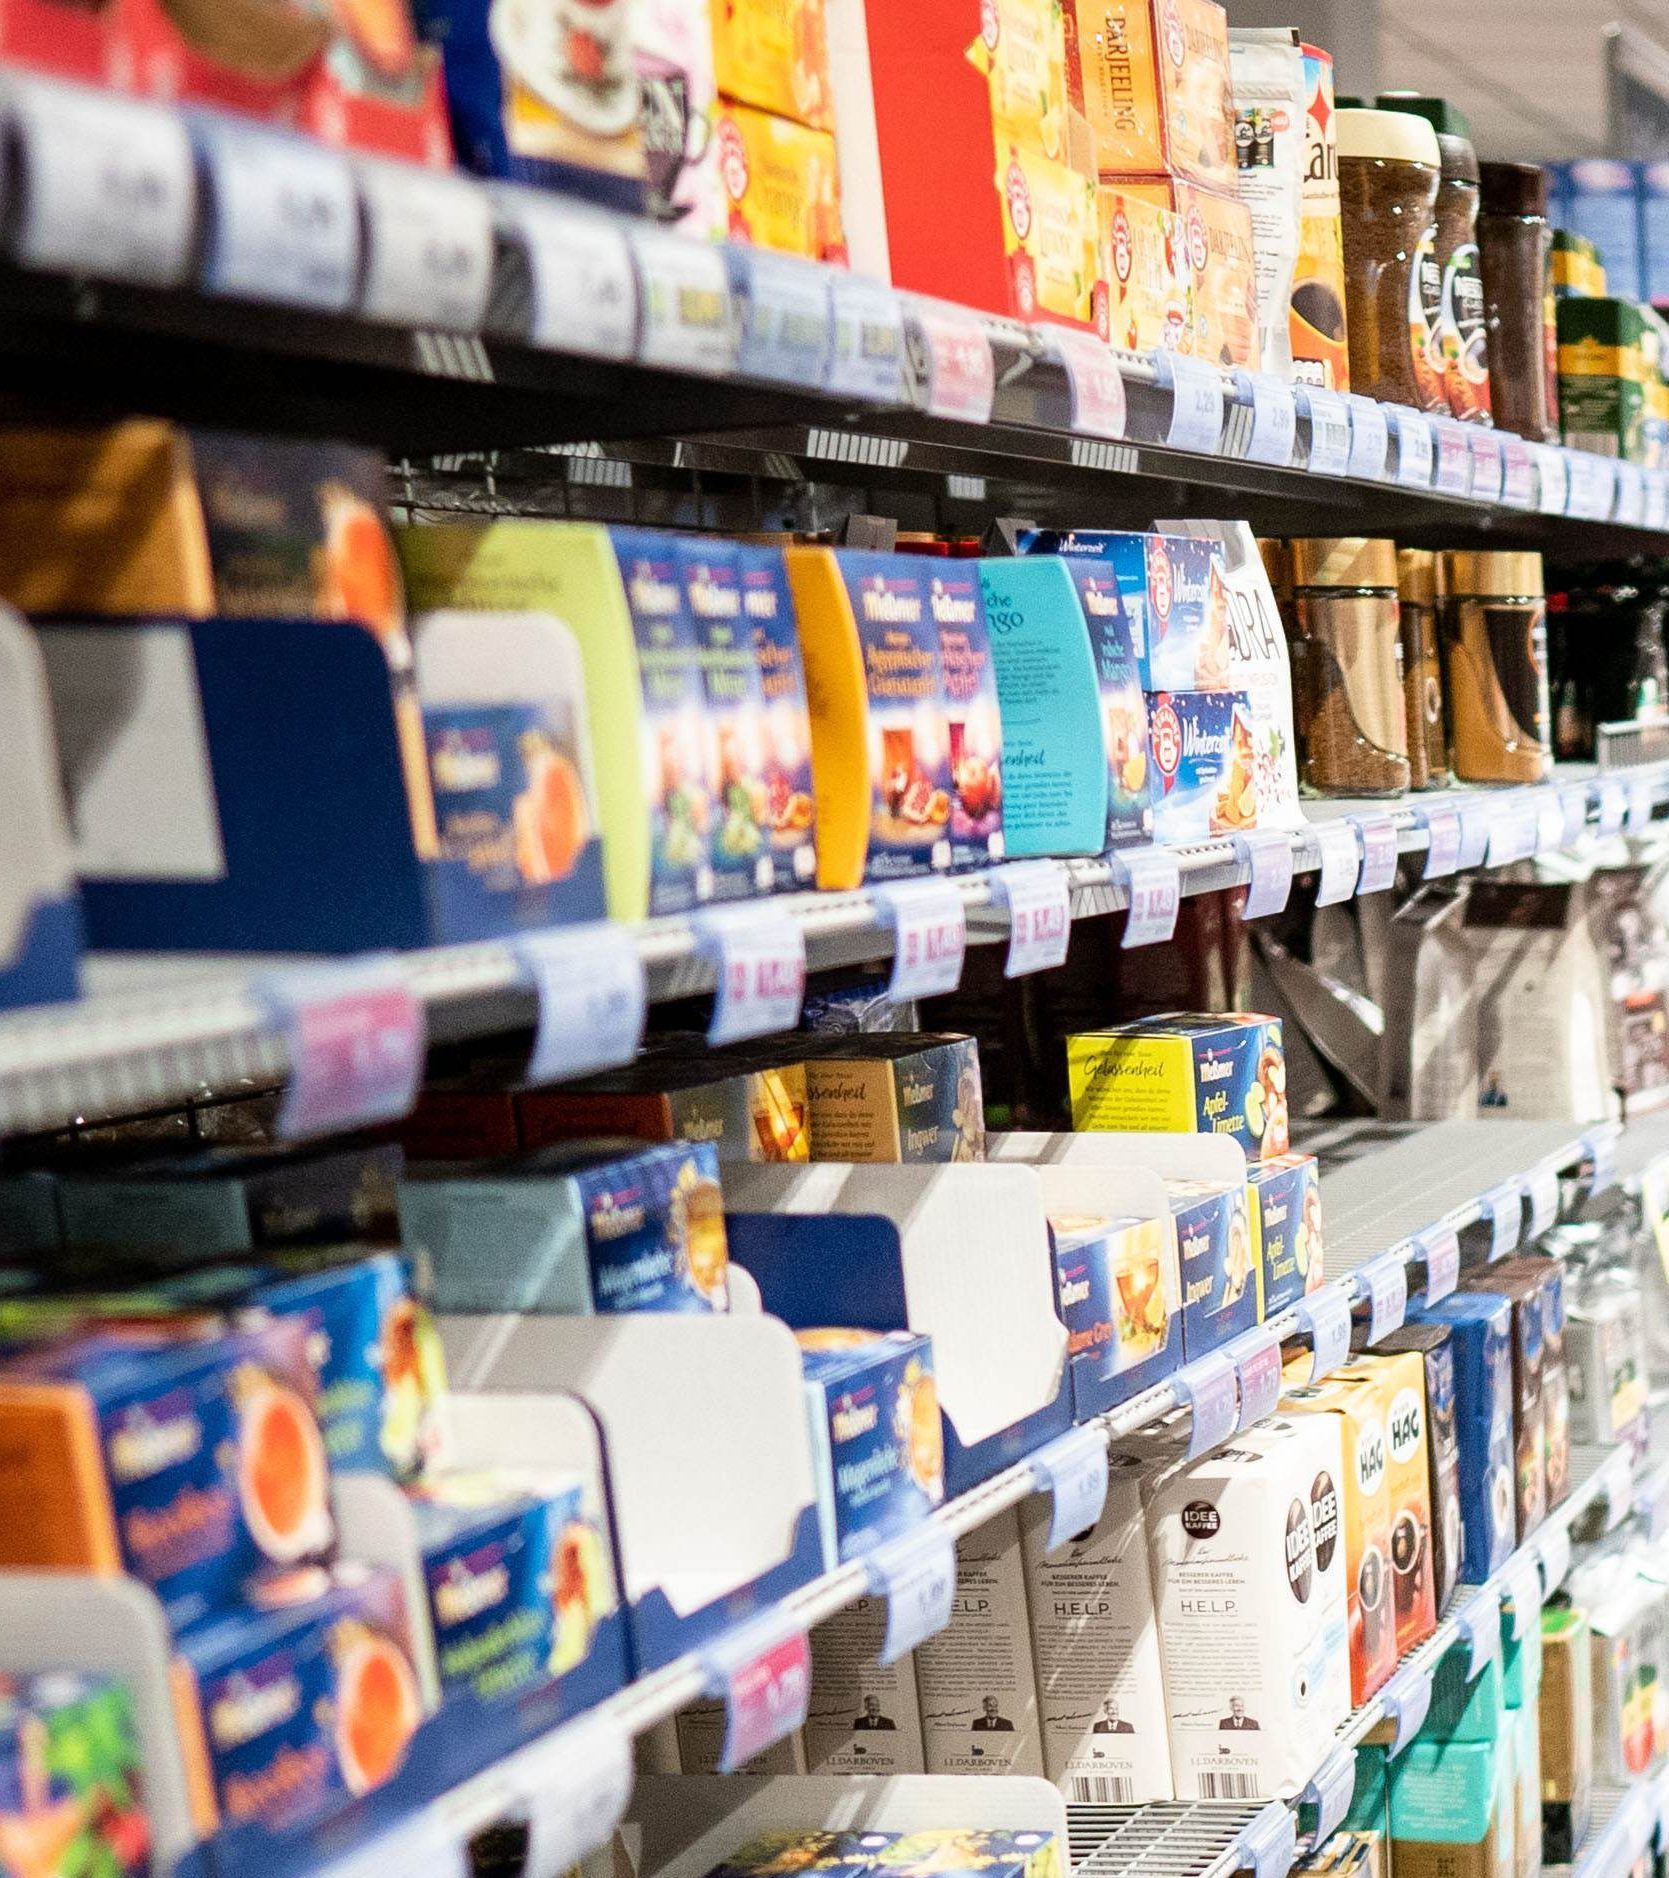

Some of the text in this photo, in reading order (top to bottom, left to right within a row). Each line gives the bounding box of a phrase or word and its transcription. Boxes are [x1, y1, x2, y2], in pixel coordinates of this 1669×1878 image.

[1103, 16, 1137, 134] DARJEELING
[1183, 1510, 1218, 1522] IDEE
[952, 1600, 992, 1613] E.L.P.
[1053, 1602, 1112, 1616] H.E.L.P.
[1180, 1600, 1239, 1613] H.E.L.P.
